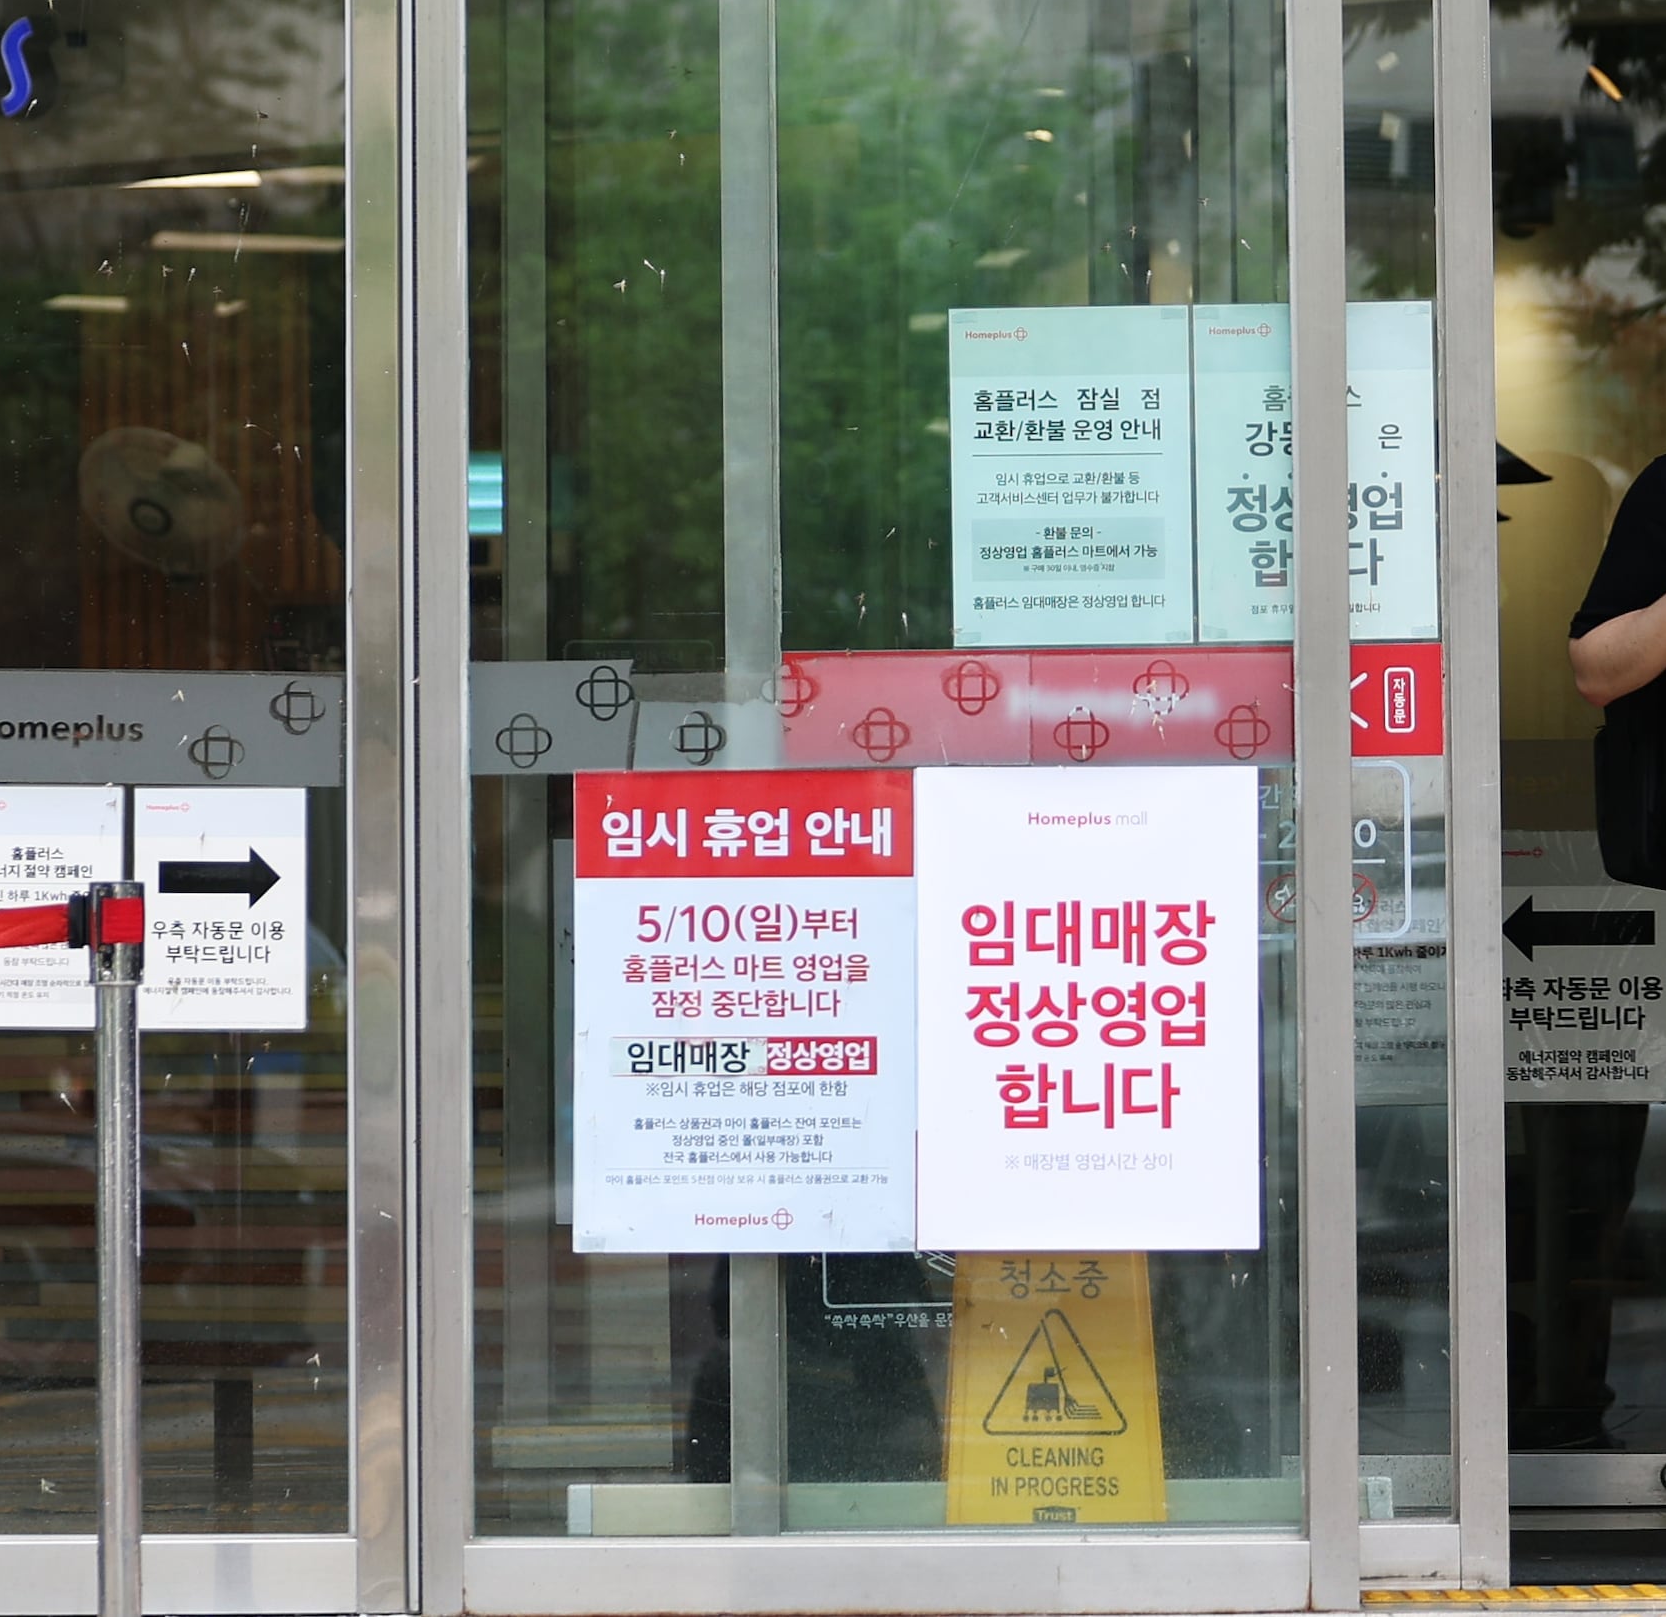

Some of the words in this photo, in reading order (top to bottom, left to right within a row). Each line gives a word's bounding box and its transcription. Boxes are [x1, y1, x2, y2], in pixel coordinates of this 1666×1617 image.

[965, 330, 1013, 341] Homeplus
[1208, 325, 1256, 337] Homeplus
[973, 389, 1058, 412] 홈플러스
[1076, 387, 1121, 411] 잠실
[1140, 387, 1161, 410] 점
[973, 419, 1066, 442] 교환/환불
[1072, 419, 1113, 441] 운영
[1120, 417, 1162, 441] 안내
[995, 472, 1019, 486] 임시
[1022, 472, 1070, 486] 휴업으로
[1072, 471, 1126, 485] 교환/환불
[1128, 471, 1140, 485] 등
[976, 492, 1059, 505] 고객서비스센터
[1062, 491, 1097, 504] 업무가
[1101, 491, 1159, 504] 불가합니다
[1043, 526, 1067, 540] 환불
[1070, 526, 1094, 539] 문의
[979, 546, 1028, 560] 정상영업
[1030, 545, 1079, 559] 홈플러스
[1082, 544, 1130, 558] 마트에서
[1133, 544, 1158, 557] 가능
[973, 596, 1019, 610] 홈플러스
[1021, 595, 1079, 609] 임대매장은
[1082, 595, 1128, 609] 정상영업
[1131, 594, 1165, 608] 합니다
[1391, 676, 1407, 725] 자동문
[1028, 812, 1112, 828] Homeplus
[1115, 811, 1148, 826] mall
[602, 808, 687, 858] 임시
[702, 808, 789, 858] 휴업
[805, 807, 893, 857] 안내
[12, 847, 64, 861] 홈플러스
[23, 864, 50, 879] 절약
[55, 864, 93, 879] 캠페인
[7, 889, 30, 902] 하루
[151, 920, 186, 941] 우측
[192, 920, 245, 941] 자동문
[251, 920, 286, 941] 이용
[636, 904, 859, 944] 5/10(일)부터
[961, 900, 1216, 967] 임대매장
[165, 945, 272, 964] 부탁드립니다
[1378, 946, 1413, 958] 1Kwh
[622, 954, 726, 983] 홈플러스
[733, 954, 786, 981] 마트
[792, 953, 870, 983] 영업을
[1543, 976, 1612, 1001] 자동문
[1619, 975, 1664, 1001] 이용
[651, 990, 703, 1018] 잠정
[711, 989, 841, 1018] 중단합니다
[965, 982, 1206, 1047] 정상영업
[1508, 1006, 1646, 1032] 부탁드립니다
[627, 1040, 751, 1074] 임대매장
[767, 1041, 871, 1071] 정상영업
[1519, 1048, 1582, 1064] 에너지절약
[1585, 1048, 1637, 1064] 캠페인에
[1506, 1065, 1583, 1082] 동참해주셔서
[1585, 1064, 1650, 1081] 감사합니다
[693, 1081, 735, 1098] 휴업은
[739, 1081, 768, 1098] 해당
[773, 1081, 815, 1098] 점포에
[820, 1081, 848, 1098] 한함
[995, 1063, 1181, 1129] 합니다
[633, 1117, 676, 1131] 홈플러스
[679, 1117, 722, 1131] 상품권과
[724, 1117, 746, 1131] 마이
[749, 1117, 792, 1131] 홈플러스
[795, 1117, 817, 1131] 잔여
[820, 1117, 862, 1131] 포인트는
[672, 1134, 715, 1148] 정상영업
[718, 1134, 740, 1148] 중인
[802, 1134, 824, 1148] 포함
[663, 1151, 684, 1164] 전국
[688, 1151, 752, 1164] 홈플러스에서
[754, 1151, 776, 1164] 사용
[779, 1151, 833, 1164] 가능합니다
[1024, 1153, 1070, 1171] 매장별
[1075, 1153, 1137, 1171] 영업시간
[1142, 1153, 1173, 1171] 상이
[694, 1212, 769, 1230] Homeplus
[1000, 1259, 1109, 1300] 청소중
[1006, 1447, 1105, 1468] CLEANING
[991, 1476, 1008, 1497] IN
[1015, 1476, 1120, 1497] PROGRESS
[1035, 1508, 1075, 1523] Trust
